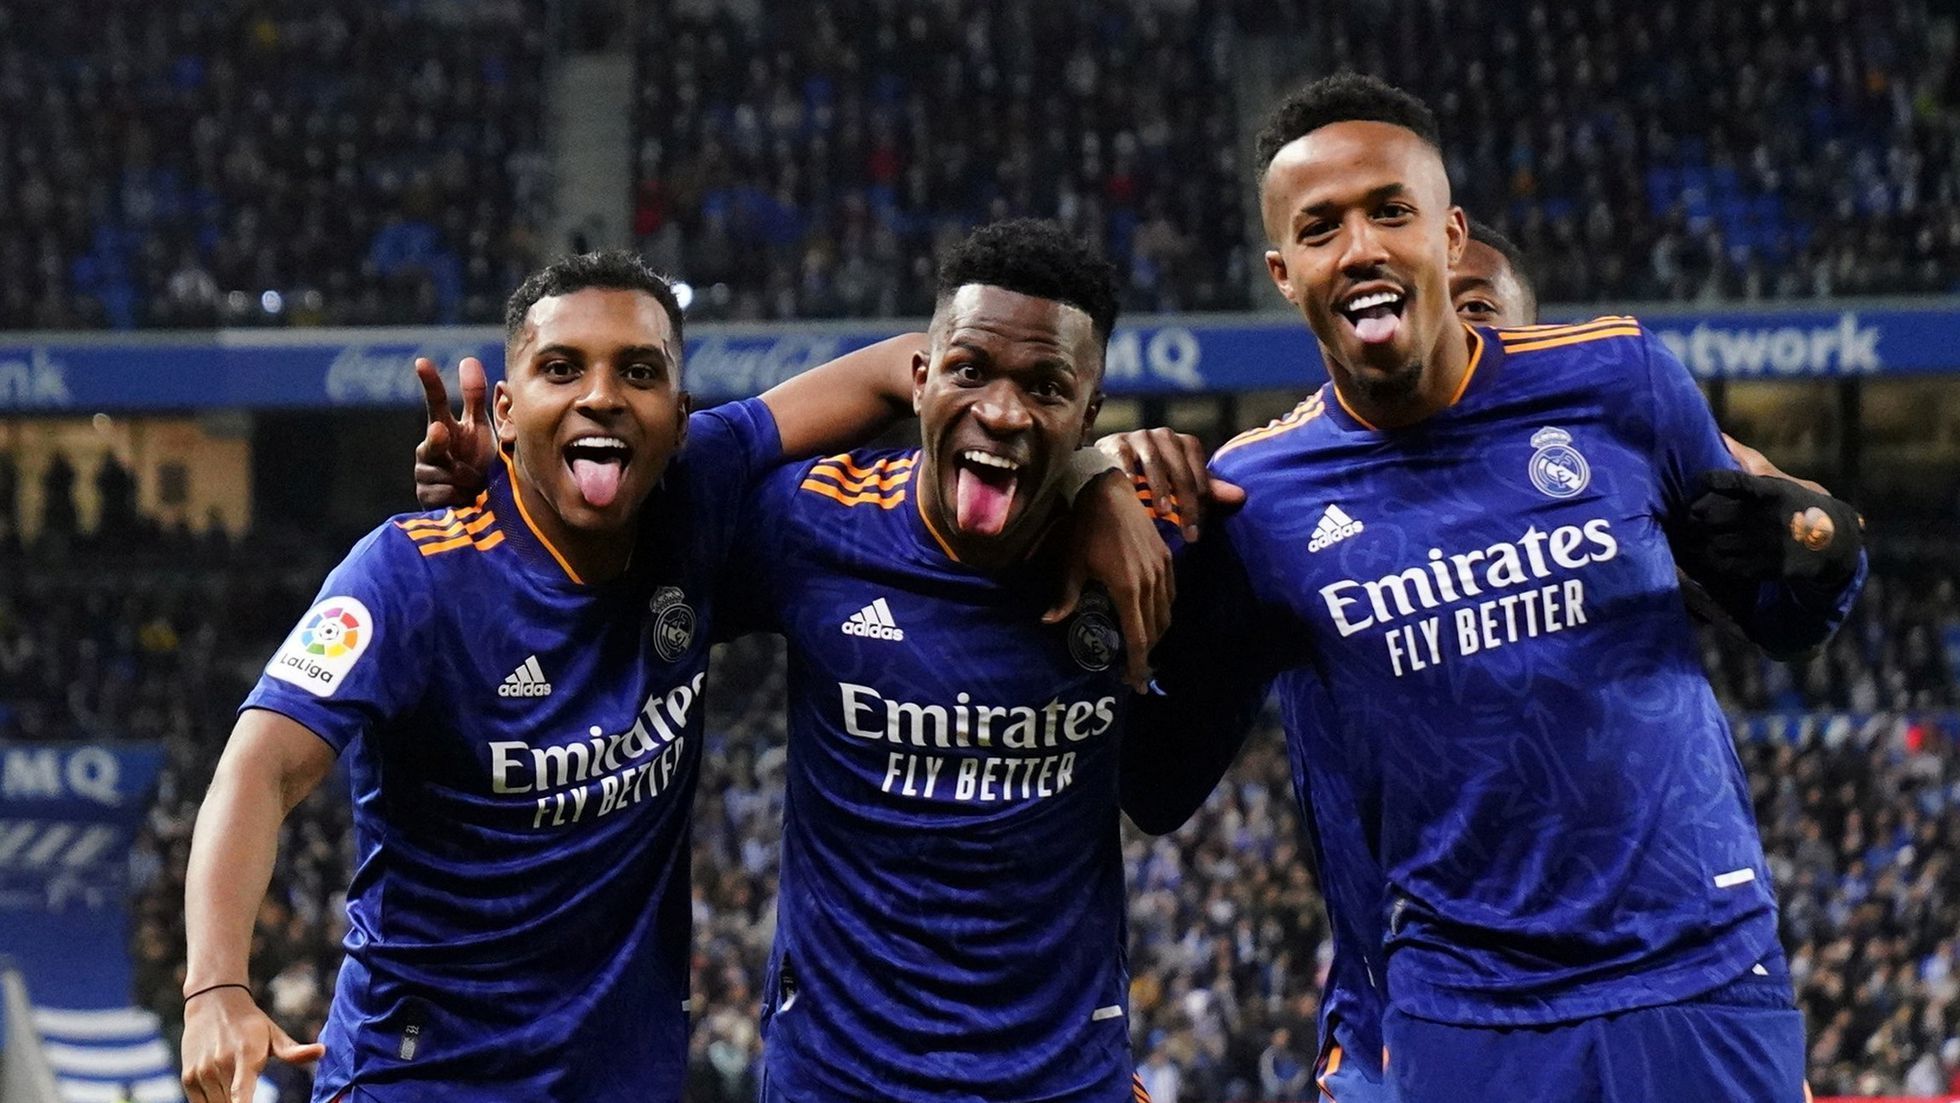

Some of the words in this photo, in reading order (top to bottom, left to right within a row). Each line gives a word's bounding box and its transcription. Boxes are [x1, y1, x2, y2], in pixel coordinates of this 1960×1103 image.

[1308, 520, 1364, 553] adidas
[1318, 519, 1618, 637] Emirates
[841, 620, 904, 641] adidas
[1385, 616, 1441, 677] FLY
[1455, 579, 1587, 656] BETTER
[498, 681, 552, 697] adidas
[838, 682, 1116, 749] Emirates
[3, 745, 121, 808] MQ
[881, 751, 944, 798] FLY
[955, 751, 1076, 801] BETTER
[533, 786, 588, 829] FLY
